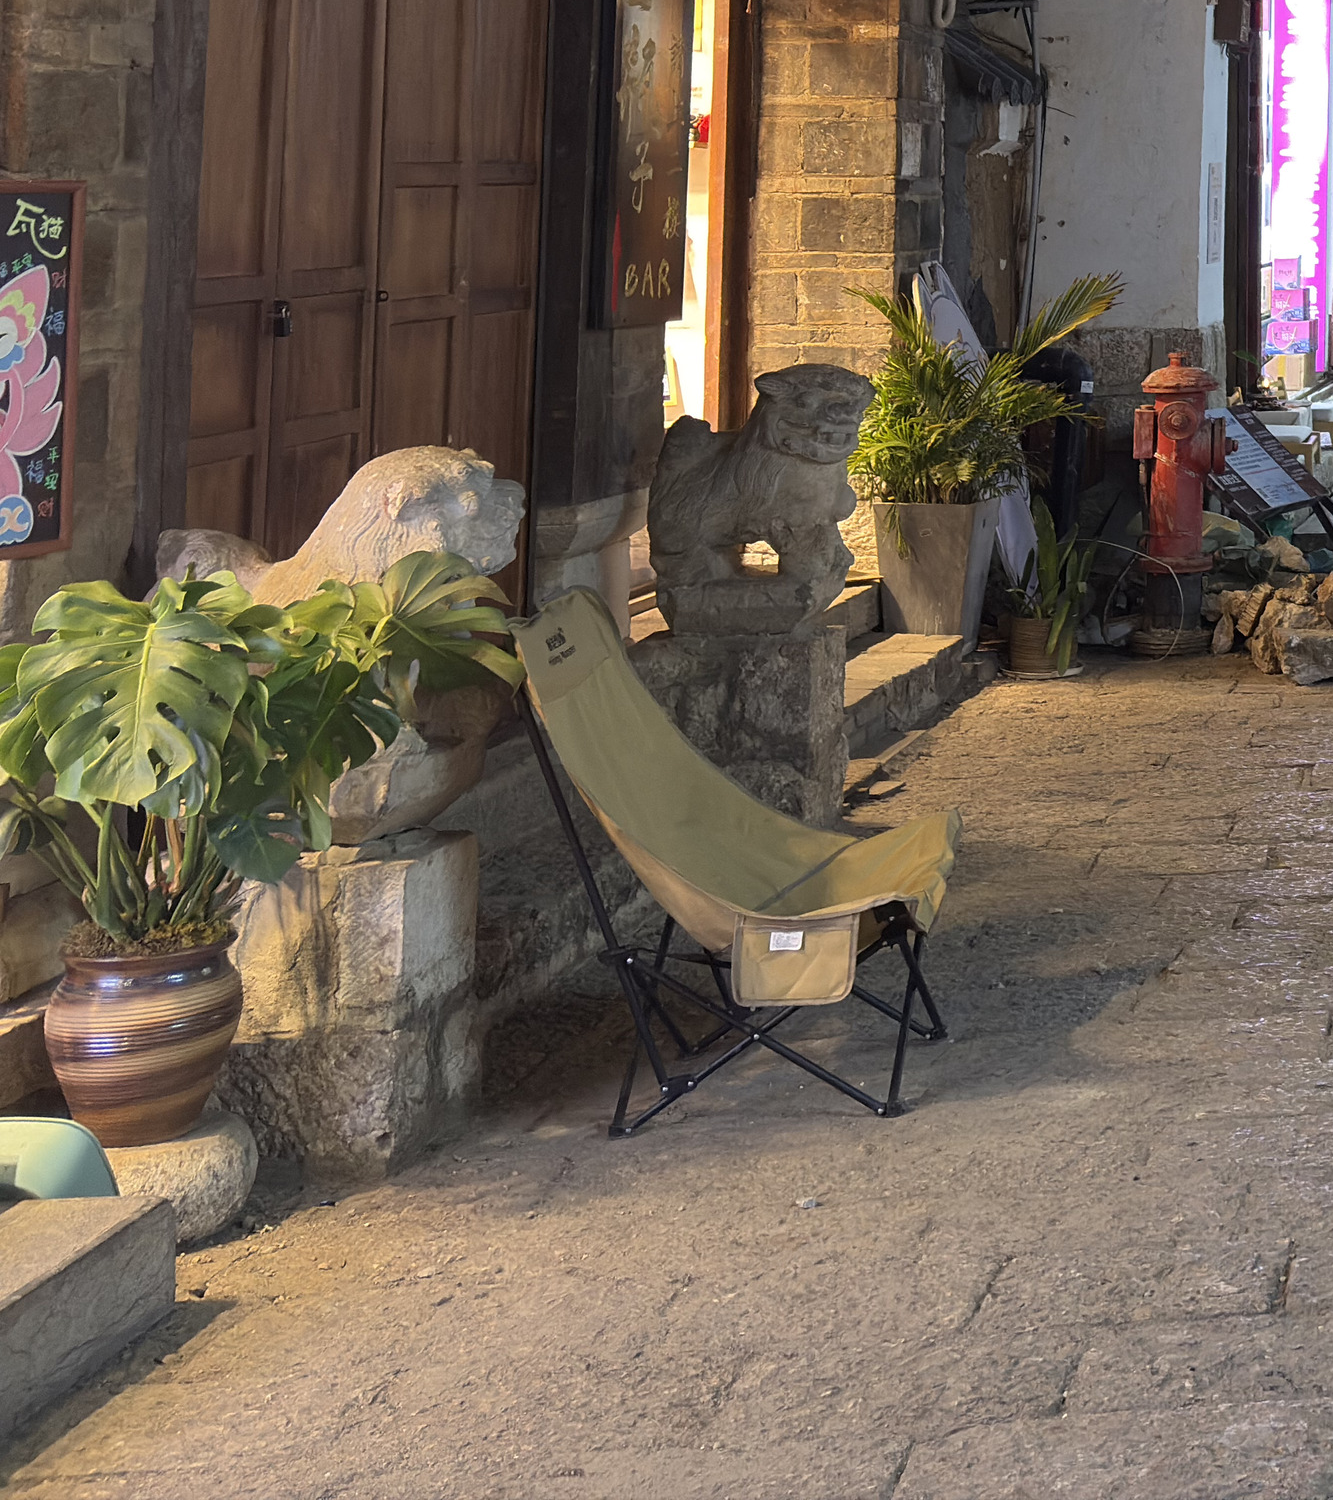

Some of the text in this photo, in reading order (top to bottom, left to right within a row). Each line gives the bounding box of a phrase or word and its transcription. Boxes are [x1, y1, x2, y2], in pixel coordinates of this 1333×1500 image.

[6, 198, 67, 260] 瓦猫
[624, 258, 671, 299] BAR
[45, 306, 66, 337] 福
